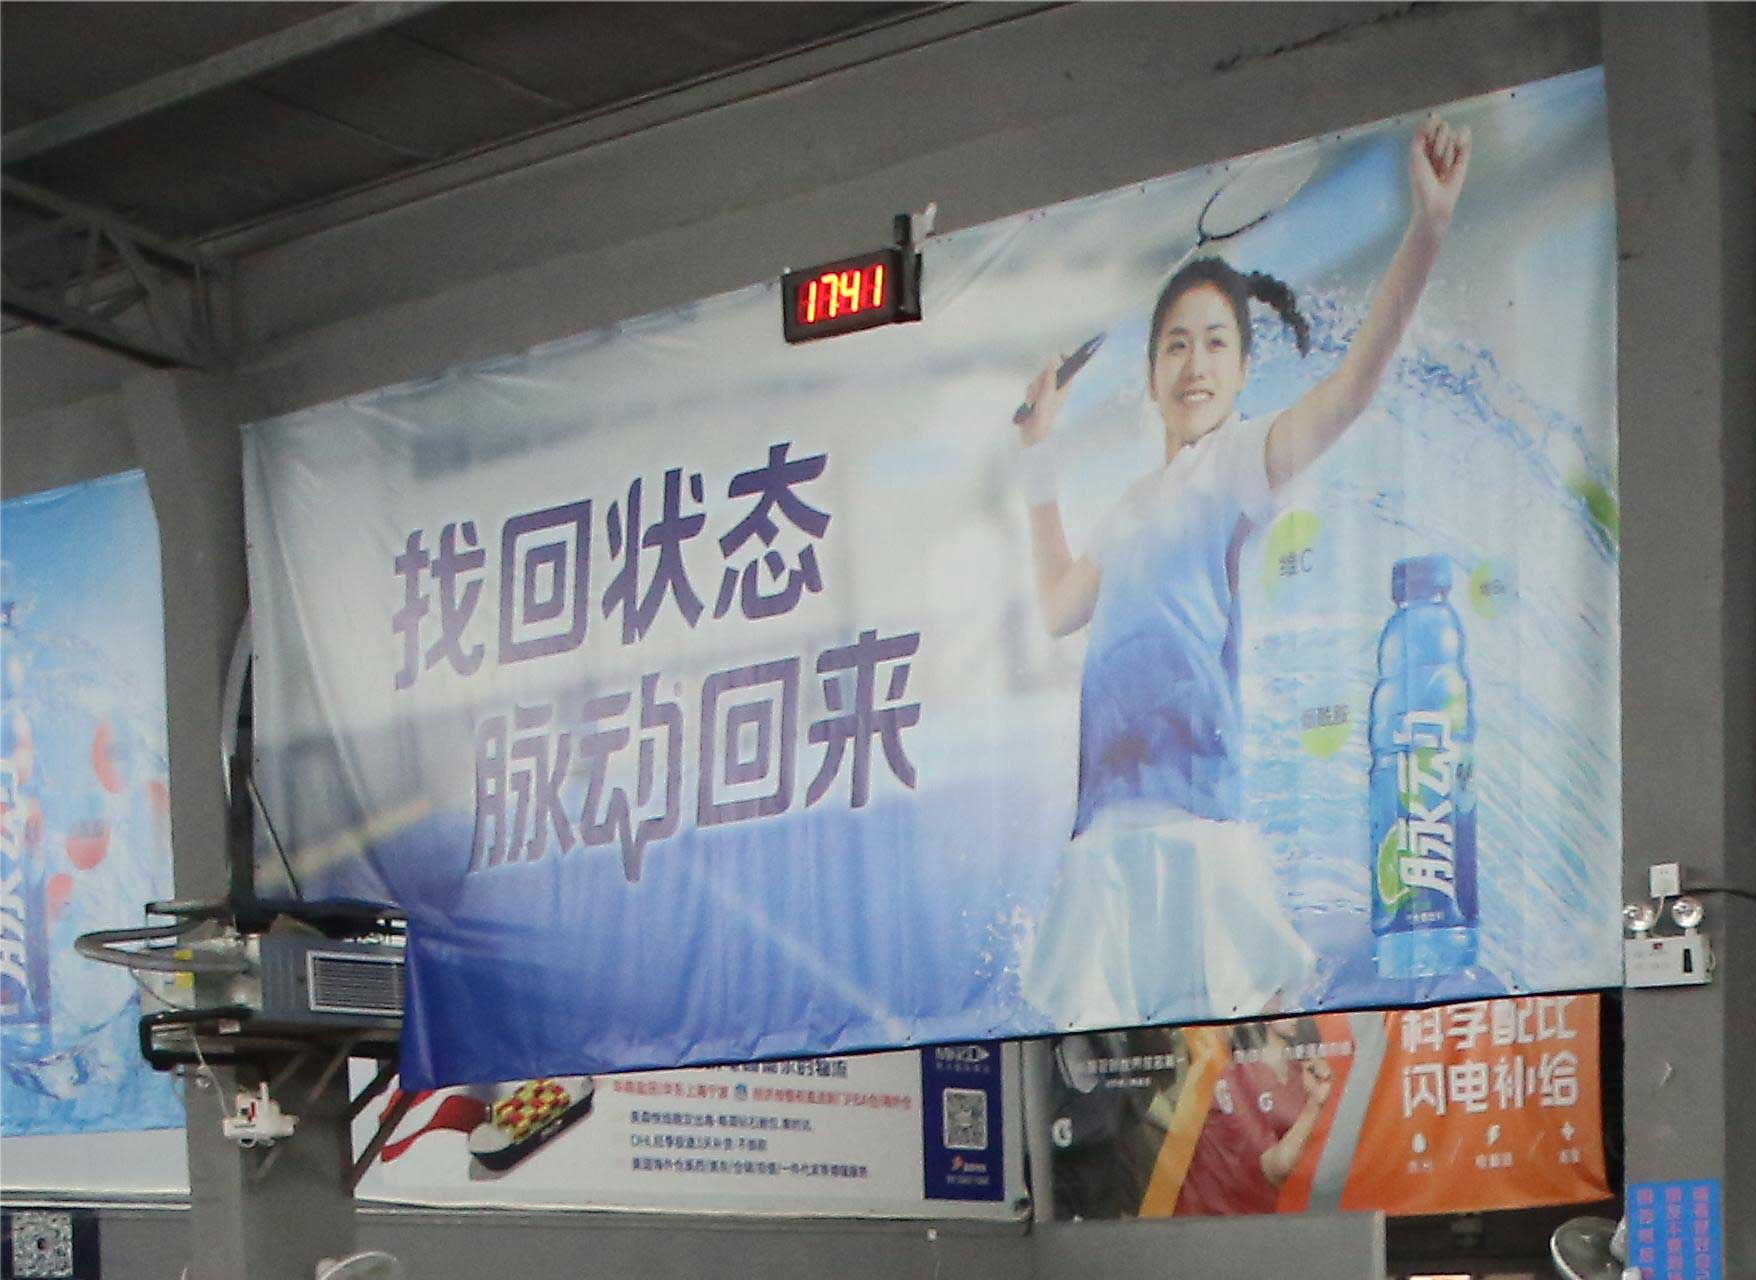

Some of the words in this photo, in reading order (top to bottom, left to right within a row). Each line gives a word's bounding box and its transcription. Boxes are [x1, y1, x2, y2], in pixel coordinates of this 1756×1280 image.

[393, 441, 832, 690] 找回状态
[467, 627, 921, 883] 脉动回来
[1393, 709, 1456, 899] 脉动
[1400, 1050, 1579, 1118] 闪电补给
